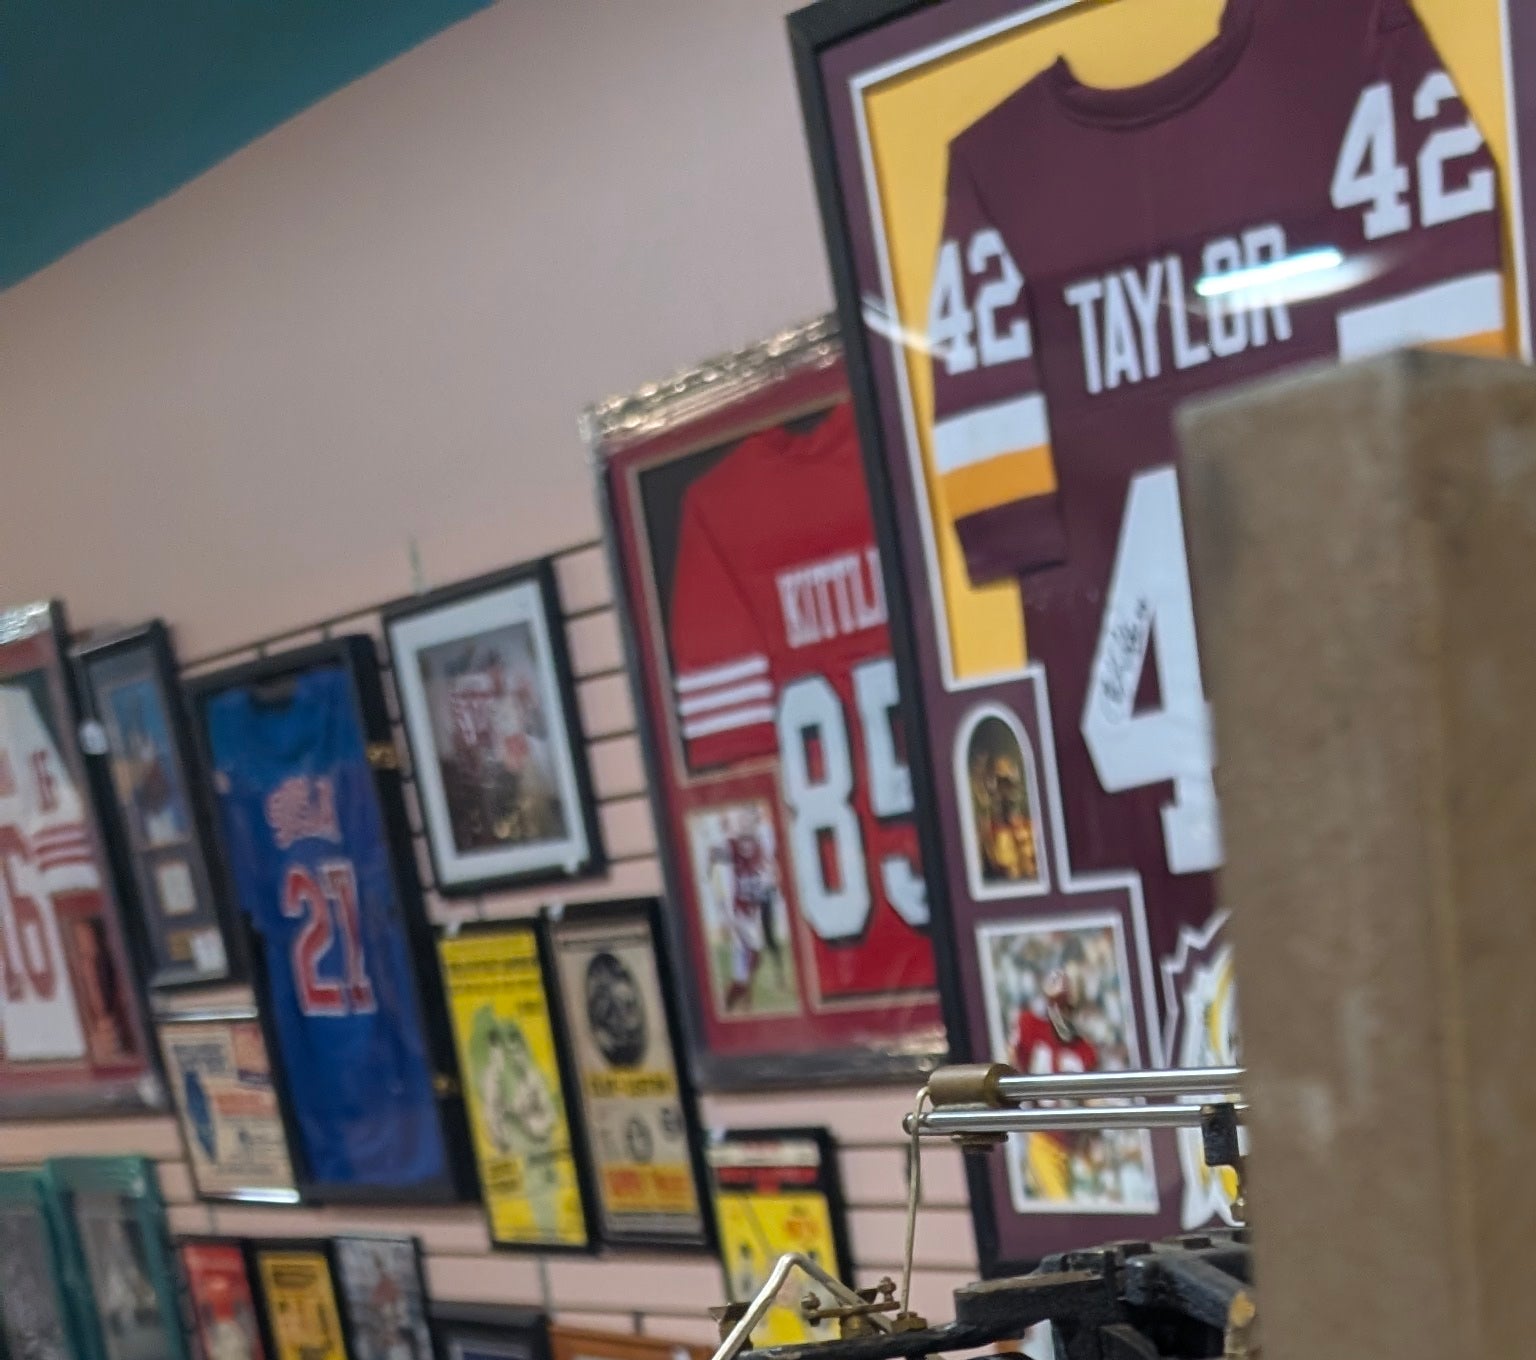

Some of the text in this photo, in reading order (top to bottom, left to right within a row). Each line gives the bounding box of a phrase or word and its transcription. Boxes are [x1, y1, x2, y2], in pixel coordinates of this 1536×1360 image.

[1331, 70, 1496, 239] 42
[927, 228, 1032, 374] 42
[1066, 222, 1292, 395] TAYLOR
[282, 861, 376, 1017] 21
